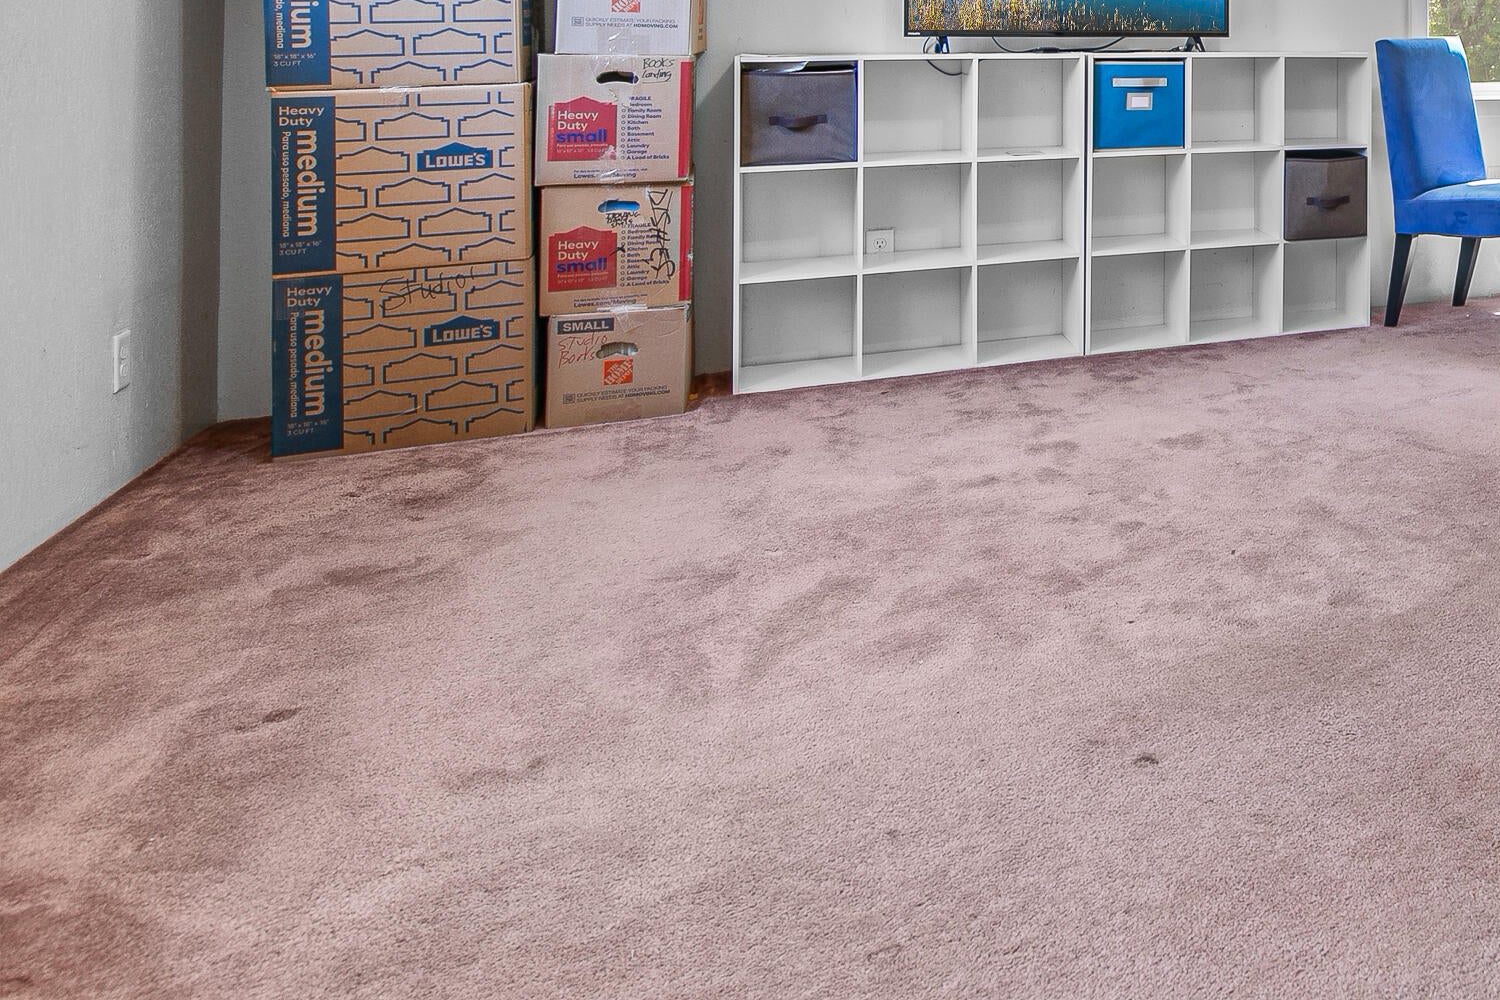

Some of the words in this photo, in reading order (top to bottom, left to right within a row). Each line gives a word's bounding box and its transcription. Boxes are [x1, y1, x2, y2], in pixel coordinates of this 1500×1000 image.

[278, 106, 325, 117] Heavy
[557, 110, 599, 121] Heavy
[278, 116, 313, 128] Duty
[557, 121, 588, 131] Duty
[282, 131, 291, 151] Para
[555, 128, 607, 143] small
[425, 153, 486, 168] LOWE'S
[296, 130, 326, 237] medium
[558, 241, 599, 252] Heavy
[558, 251, 589, 261] Duty
[555, 257, 607, 273] small
[287, 286, 333, 297] Heavy
[287, 298, 321, 308] Duty
[562, 320, 610, 332] SMALL
[432, 326, 493, 343] LOWE'S
[304, 309, 334, 416] medium
